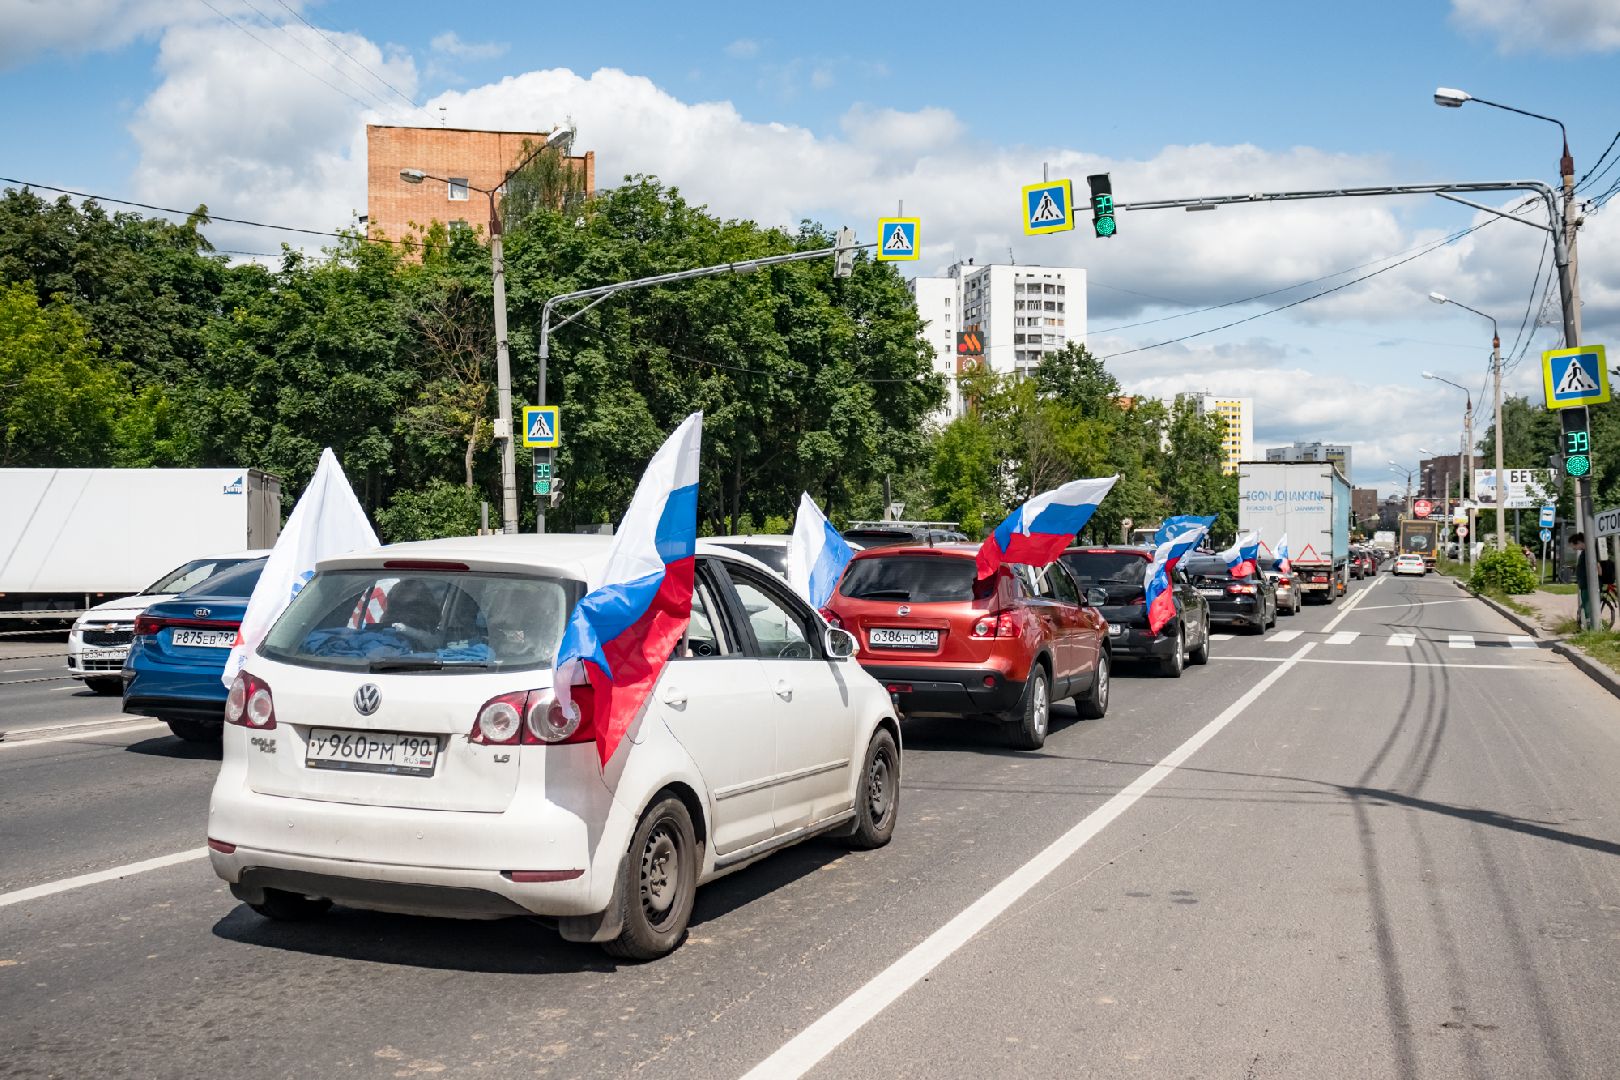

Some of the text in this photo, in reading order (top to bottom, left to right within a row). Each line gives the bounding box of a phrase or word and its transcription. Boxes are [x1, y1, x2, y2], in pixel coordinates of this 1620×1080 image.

[1096, 196, 1113, 214] 39
[1568, 431, 1588, 452] 39
[1599, 512, 1620, 532] СТО
[194, 608, 211, 617] KIA
[251, 737, 276, 748] GOLF
